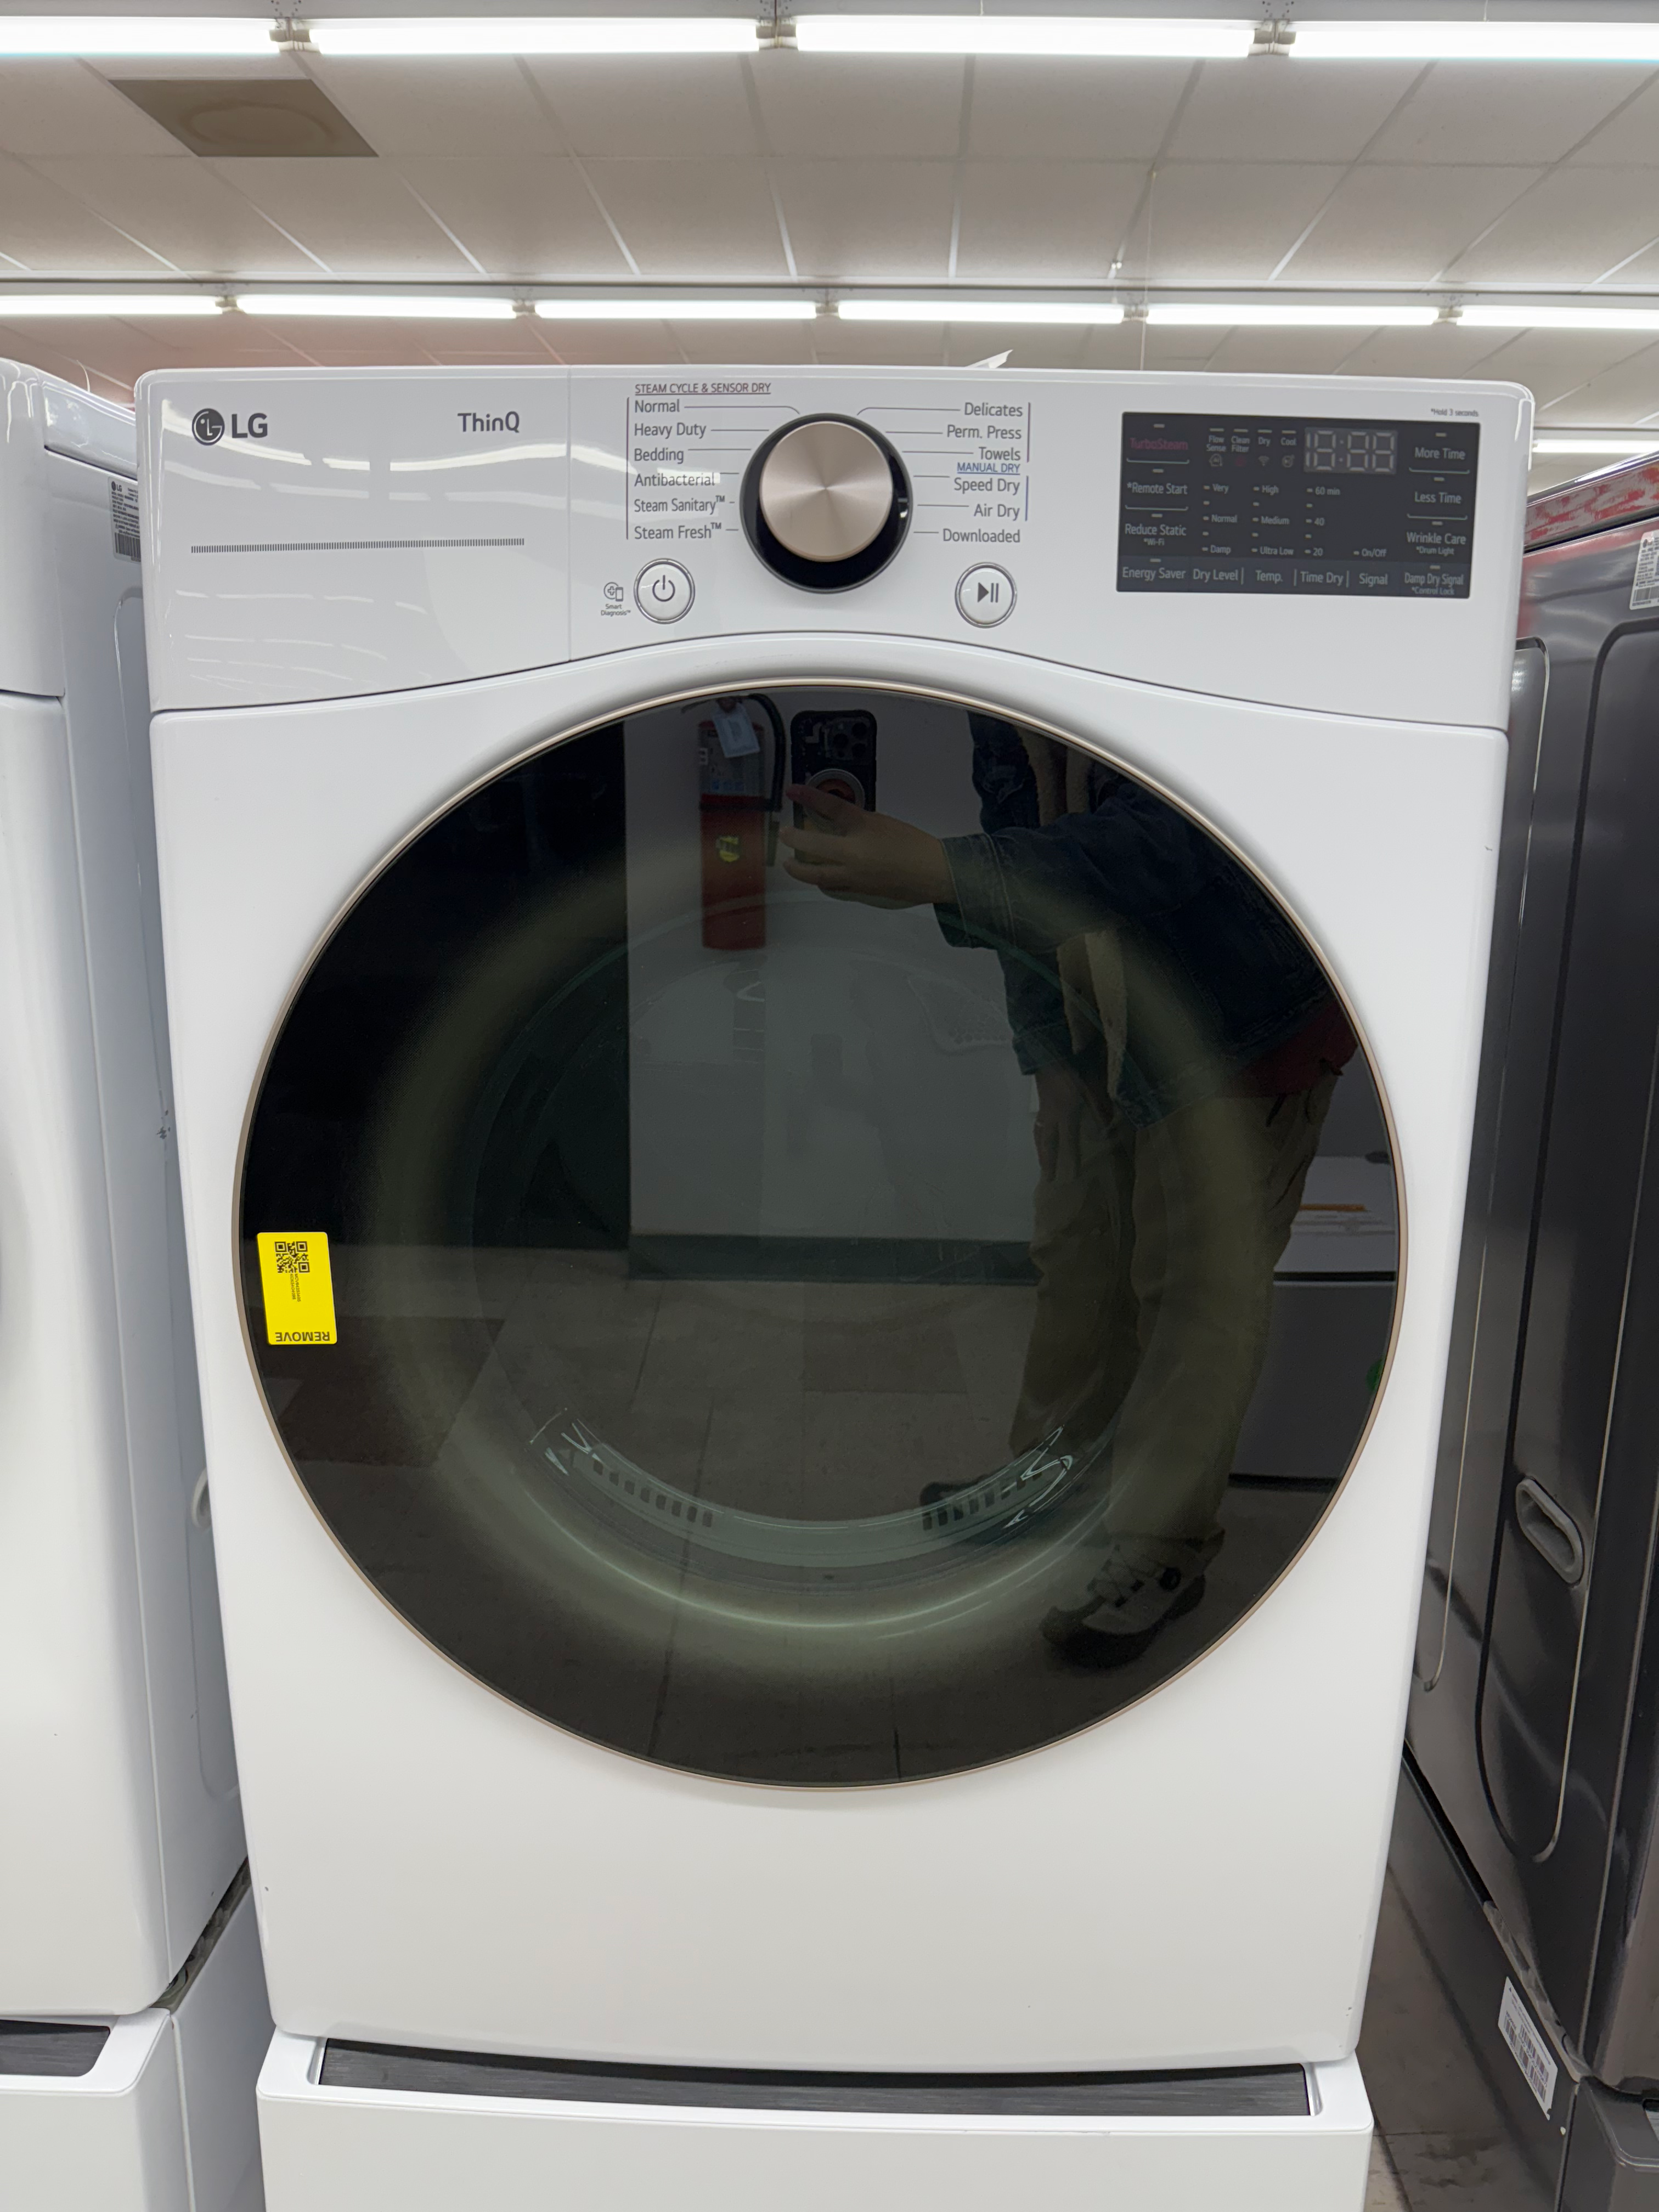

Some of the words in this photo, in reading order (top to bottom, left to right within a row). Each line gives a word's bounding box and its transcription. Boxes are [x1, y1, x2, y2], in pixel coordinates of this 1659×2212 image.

[635, 383, 667, 394] STEAM
[669, 383, 698, 393] CYCLE
[701, 383, 708, 393] &
[711, 383, 748, 393] SENSOR
[752, 382, 771, 392] DRY
[634, 399, 680, 413] Normal
[964, 402, 1023, 417] Delicates
[231, 413, 268, 439] LG
[458, 411, 520, 432] ThinQ
[634, 423, 673, 439] Heavy
[676, 422, 707, 439] Duty
[947, 425, 983, 438] Perm.
[987, 425, 1022, 439] Press
[1130, 438, 1189, 450] TurboSteam
[1208, 435, 1224, 444] Flow
[1231, 436, 1250, 444] Clean
[1258, 437, 1271, 447] Dry
[1281, 438, 1296, 446] Cool
[979, 447, 1021, 461] Towels
[1232, 444, 1249, 453] Filter
[1415, 447, 1440, 459] More
[1442, 448, 1465, 460] Time
[634, 448, 684, 464] Bedding
[957, 462, 998, 472] MANUAL
[1001, 464, 1020, 473] DRY
[634, 472, 715, 487] Antibacterial
[954, 477, 992, 494] Speed
[997, 478, 1020, 495] Dry
[1166, 483, 1188, 494] Start
[1212, 483, 1229, 493] Very
[1262, 485, 1279, 495] High
[1315, 487, 1325, 495] 60
[1415, 492, 1436, 503] Less
[1438, 492, 1462, 504] Time
[634, 499, 668, 512] Steam
[973, 504, 993, 517] Air
[997, 504, 1020, 521] Dry
[1211, 515, 1238, 523] Normal
[1261, 516, 1290, 525] Medium
[1314, 517, 1325, 526] 40
[634, 526, 674, 539] Steam
[943, 528, 1020, 543] Downloaded
[1125, 523, 1157, 535] Reduce
[1160, 524, 1187, 536] Static
[1406, 531, 1442, 544] Wrinkle
[1444, 533, 1466, 545] Care
[1210, 545, 1231, 555] Damp
[1260, 546, 1278, 555] Ultra
[1279, 546, 1294, 556] Low
[1313, 548, 1323, 556] 20
[1361, 549, 1387, 558] On/Off
[1438, 547, 1454, 556] Light
[1122, 567, 1156, 581] Energy
[1159, 567, 1186, 579] Saver
[1193, 568, 1211, 583] Dry
[1213, 569, 1238, 581] Level
[1255, 570, 1283, 584] Temp.
[1300, 571, 1324, 583] Time
[1326, 572, 1344, 586] Dry
[1404, 572, 1425, 586] Damp
[1427, 573, 1441, 587] Dry
[1442, 574, 1464, 588] Signal
[1359, 573, 1389, 588] Signal
[1440, 588, 1454, 596] Lock
[275, 1331, 331, 1342] REMOVE
